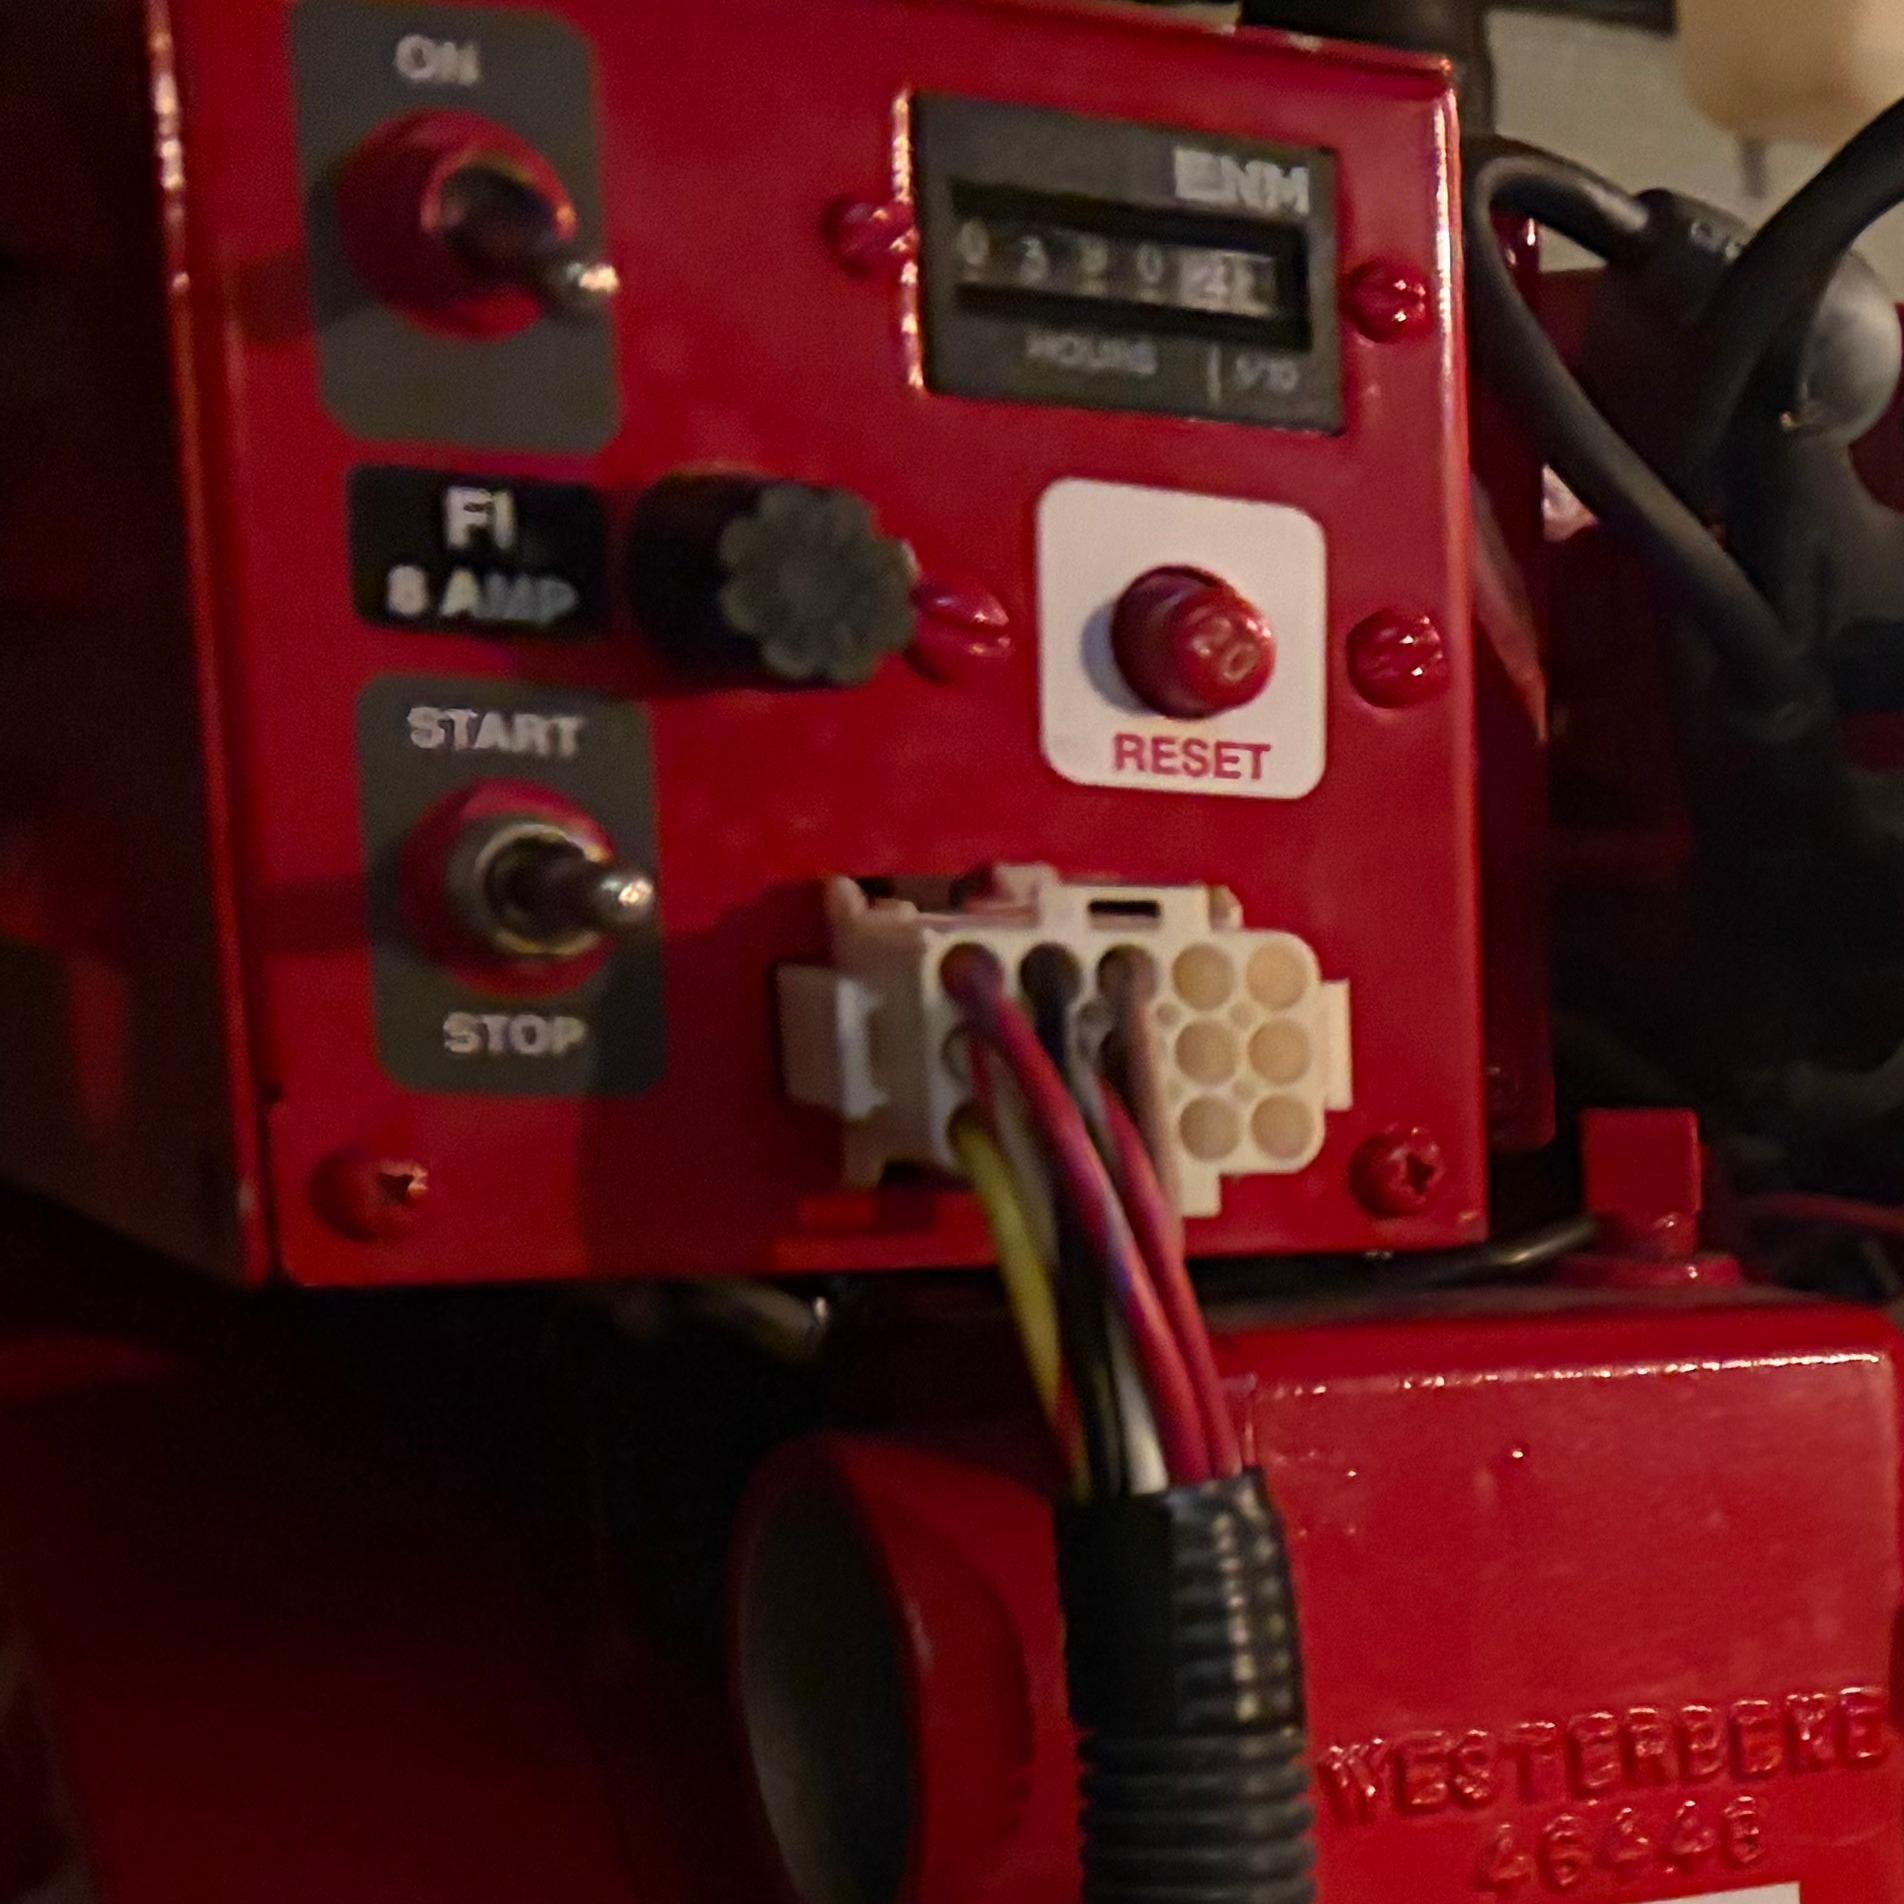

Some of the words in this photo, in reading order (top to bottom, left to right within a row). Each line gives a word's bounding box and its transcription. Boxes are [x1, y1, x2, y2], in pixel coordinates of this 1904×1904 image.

[394, 33, 481, 86] ON
[406, 704, 587, 758] START
[1111, 731, 1272, 782] RESET
[442, 1011, 590, 1057] STOP
[1315, 1687, 1888, 1828] WESTERBEKE
